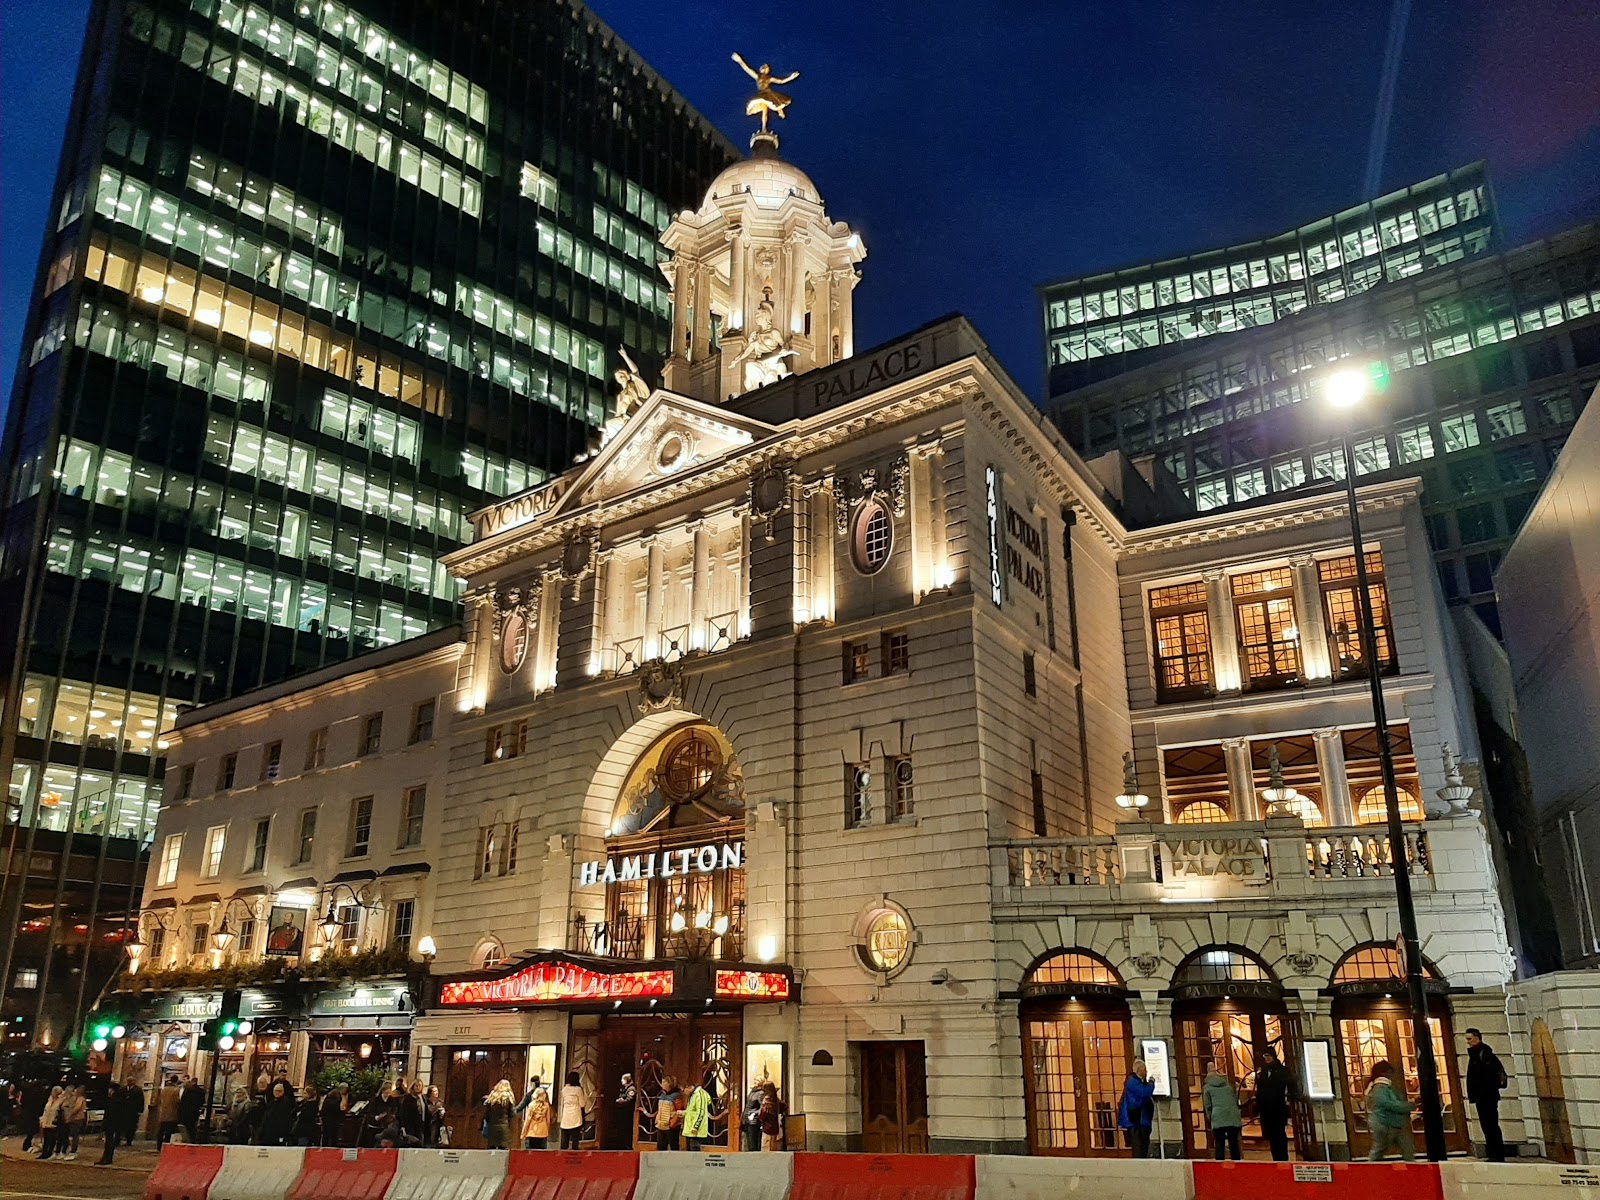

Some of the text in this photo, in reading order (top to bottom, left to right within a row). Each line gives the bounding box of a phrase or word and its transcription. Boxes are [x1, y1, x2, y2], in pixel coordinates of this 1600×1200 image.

[814, 343, 922, 407] PALACE
[482, 484, 561, 532] VICTORIA
[986, 467, 1001, 606] HAMILTON
[1005, 501, 1042, 561] VICTORIA
[1007, 543, 1044, 602] PALACE
[580, 842, 742, 886] HAMILTON
[1165, 838, 1261, 857] VICTORIA
[1172, 858, 1255, 877] PALACE
[373, 997, 394, 1006] DINING
[481, 966, 624, 999] VICTORIA PALACE
[171, 1004, 185, 1016] THE
[186, 1003, 206, 1016] DUKE
[207, 1003, 218, 1016] OF
[454, 1026, 471, 1034] EXIT
